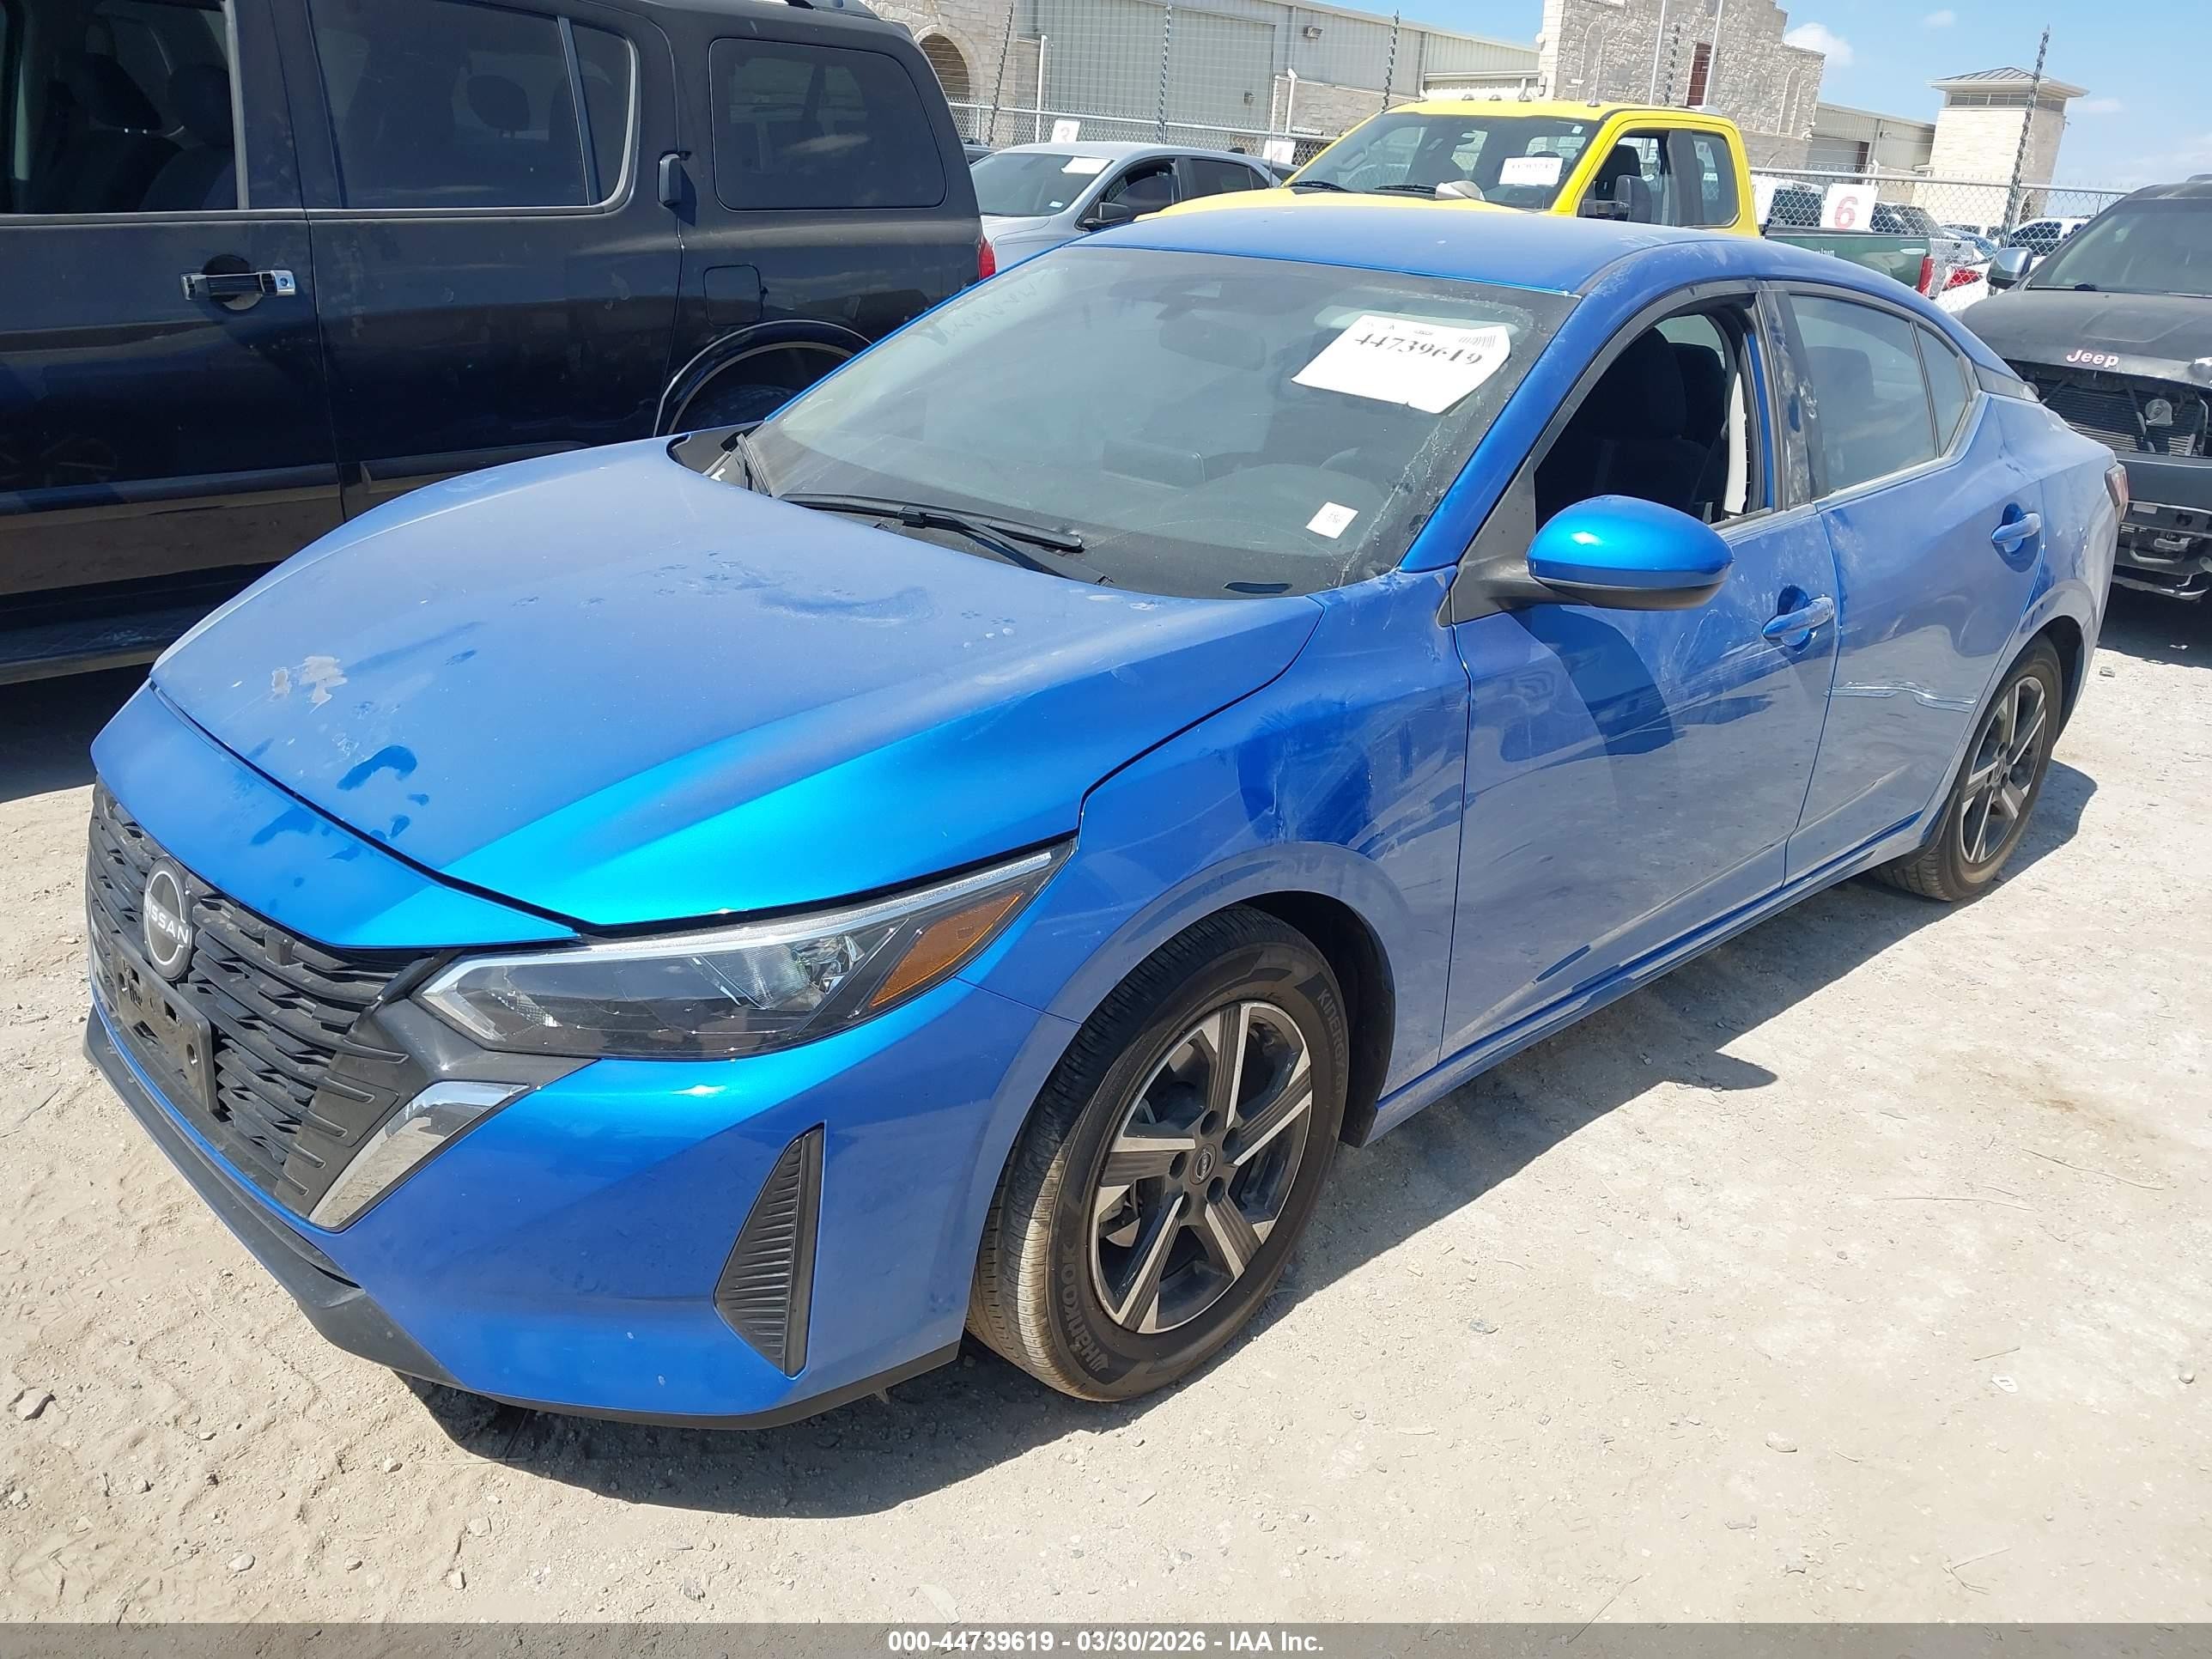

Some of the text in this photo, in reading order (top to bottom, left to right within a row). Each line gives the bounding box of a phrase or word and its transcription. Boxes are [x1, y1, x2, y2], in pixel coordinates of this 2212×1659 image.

[1834, 196, 1859, 229] 6
[2066, 349, 2119, 368] Jeep
[144, 896, 189, 945] NISSAN
[1316, 988, 1346, 1068] KINERGY
